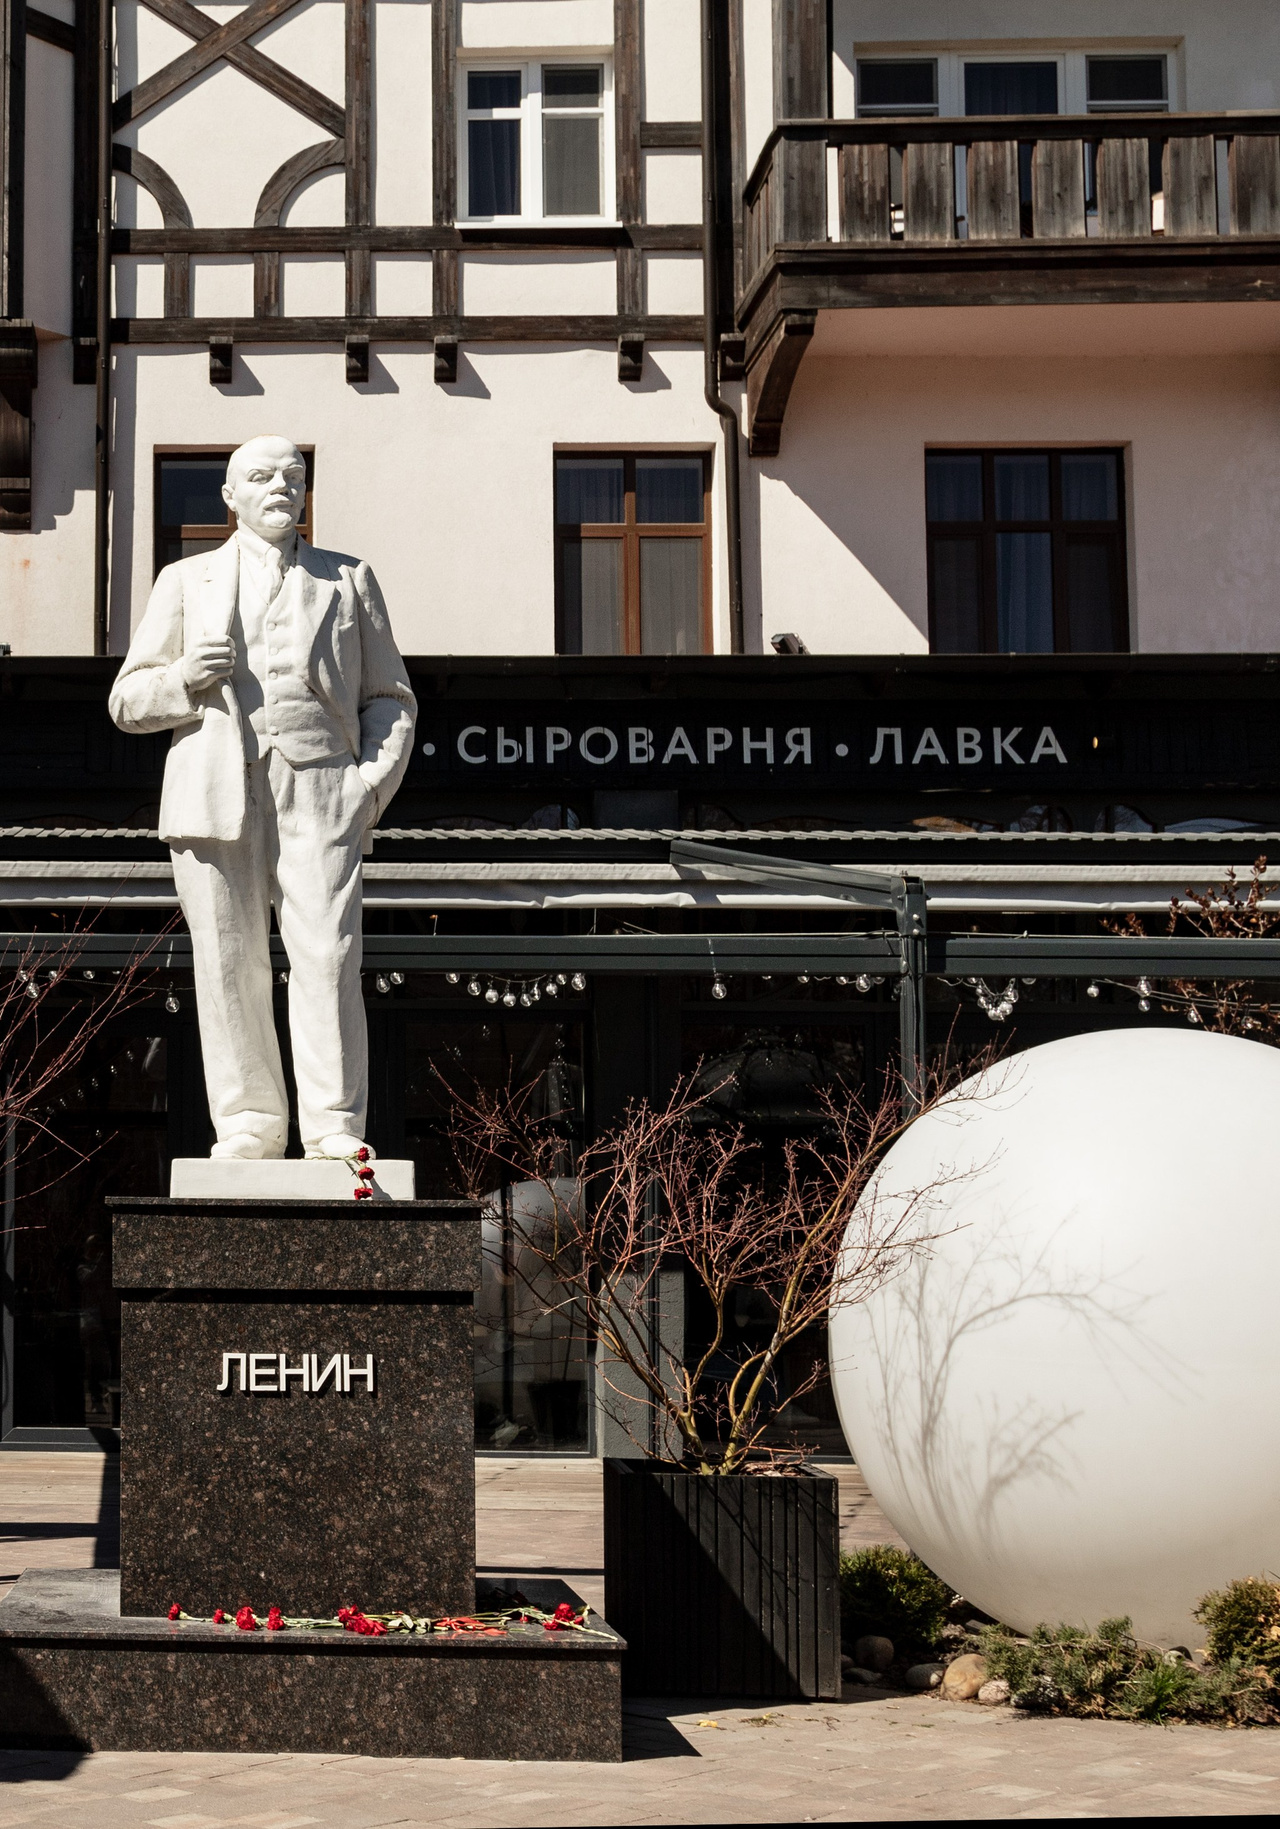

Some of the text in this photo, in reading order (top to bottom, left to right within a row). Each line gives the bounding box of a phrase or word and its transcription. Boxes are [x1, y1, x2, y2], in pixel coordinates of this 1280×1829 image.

[457, 725, 1068, 765] СЫРОВАРНЯ ЛАВКА
[216, 1352, 374, 1392] ЛЕНИН
